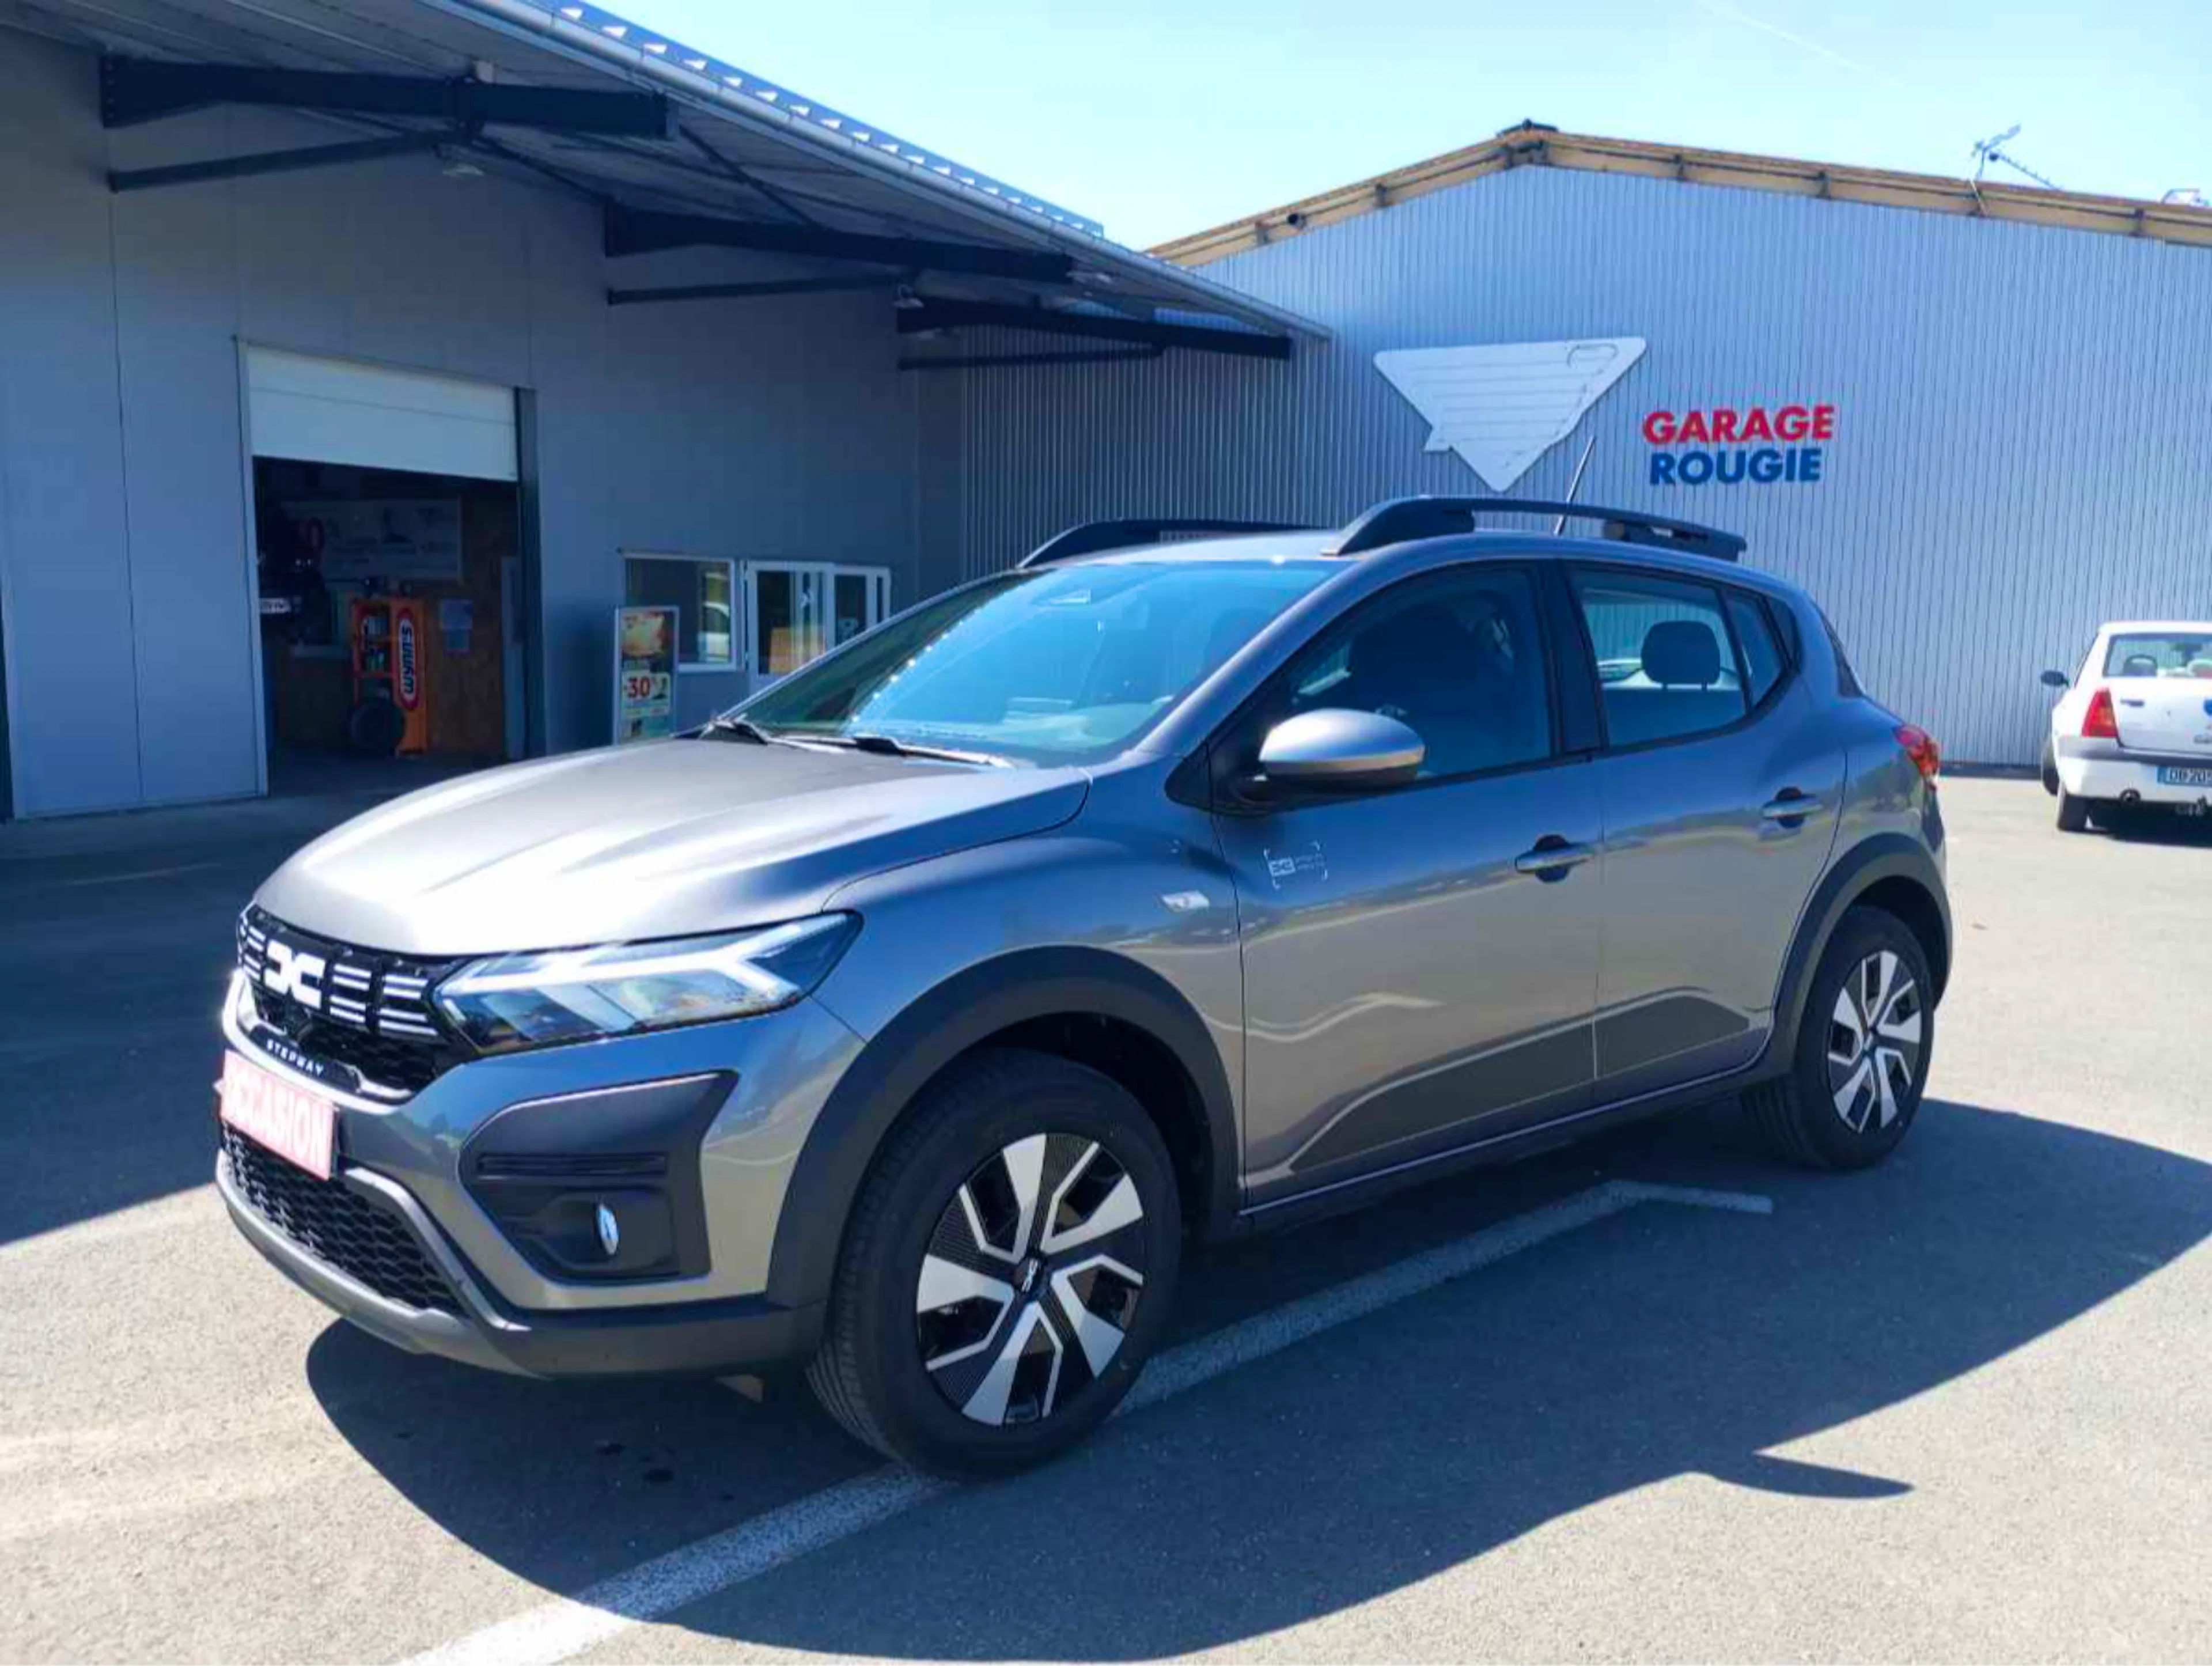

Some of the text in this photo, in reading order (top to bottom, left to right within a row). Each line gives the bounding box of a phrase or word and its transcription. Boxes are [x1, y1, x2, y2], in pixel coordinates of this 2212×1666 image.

[1642, 404, 1834, 444] GARAGE
[1649, 448, 1821, 486] ROUGIE
[266, 1038, 325, 1076] STEPWAY
